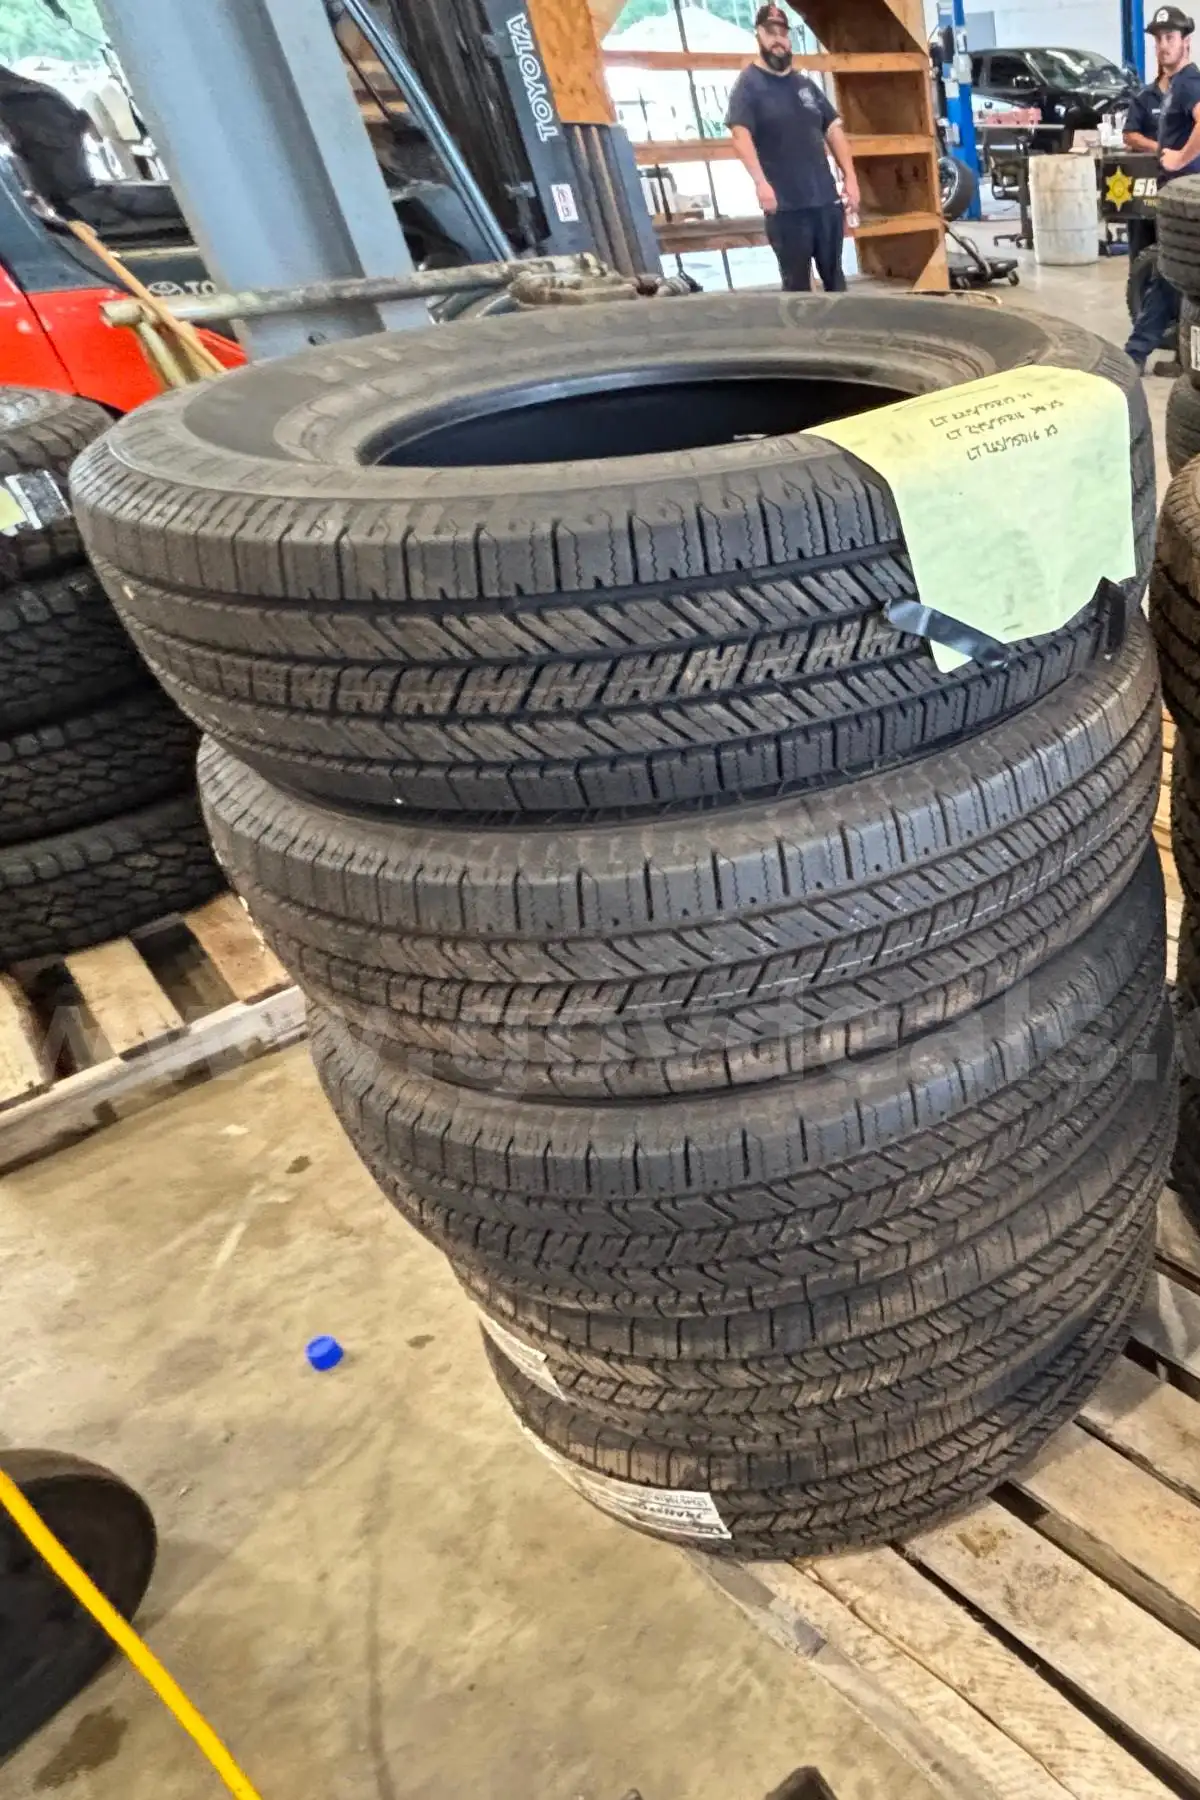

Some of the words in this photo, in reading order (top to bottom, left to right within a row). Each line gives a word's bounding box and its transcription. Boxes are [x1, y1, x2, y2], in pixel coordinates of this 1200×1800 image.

[505, 12, 559, 142] TOYOTA
[945, 428, 962, 441] LT
[966, 446, 982, 461] LT
